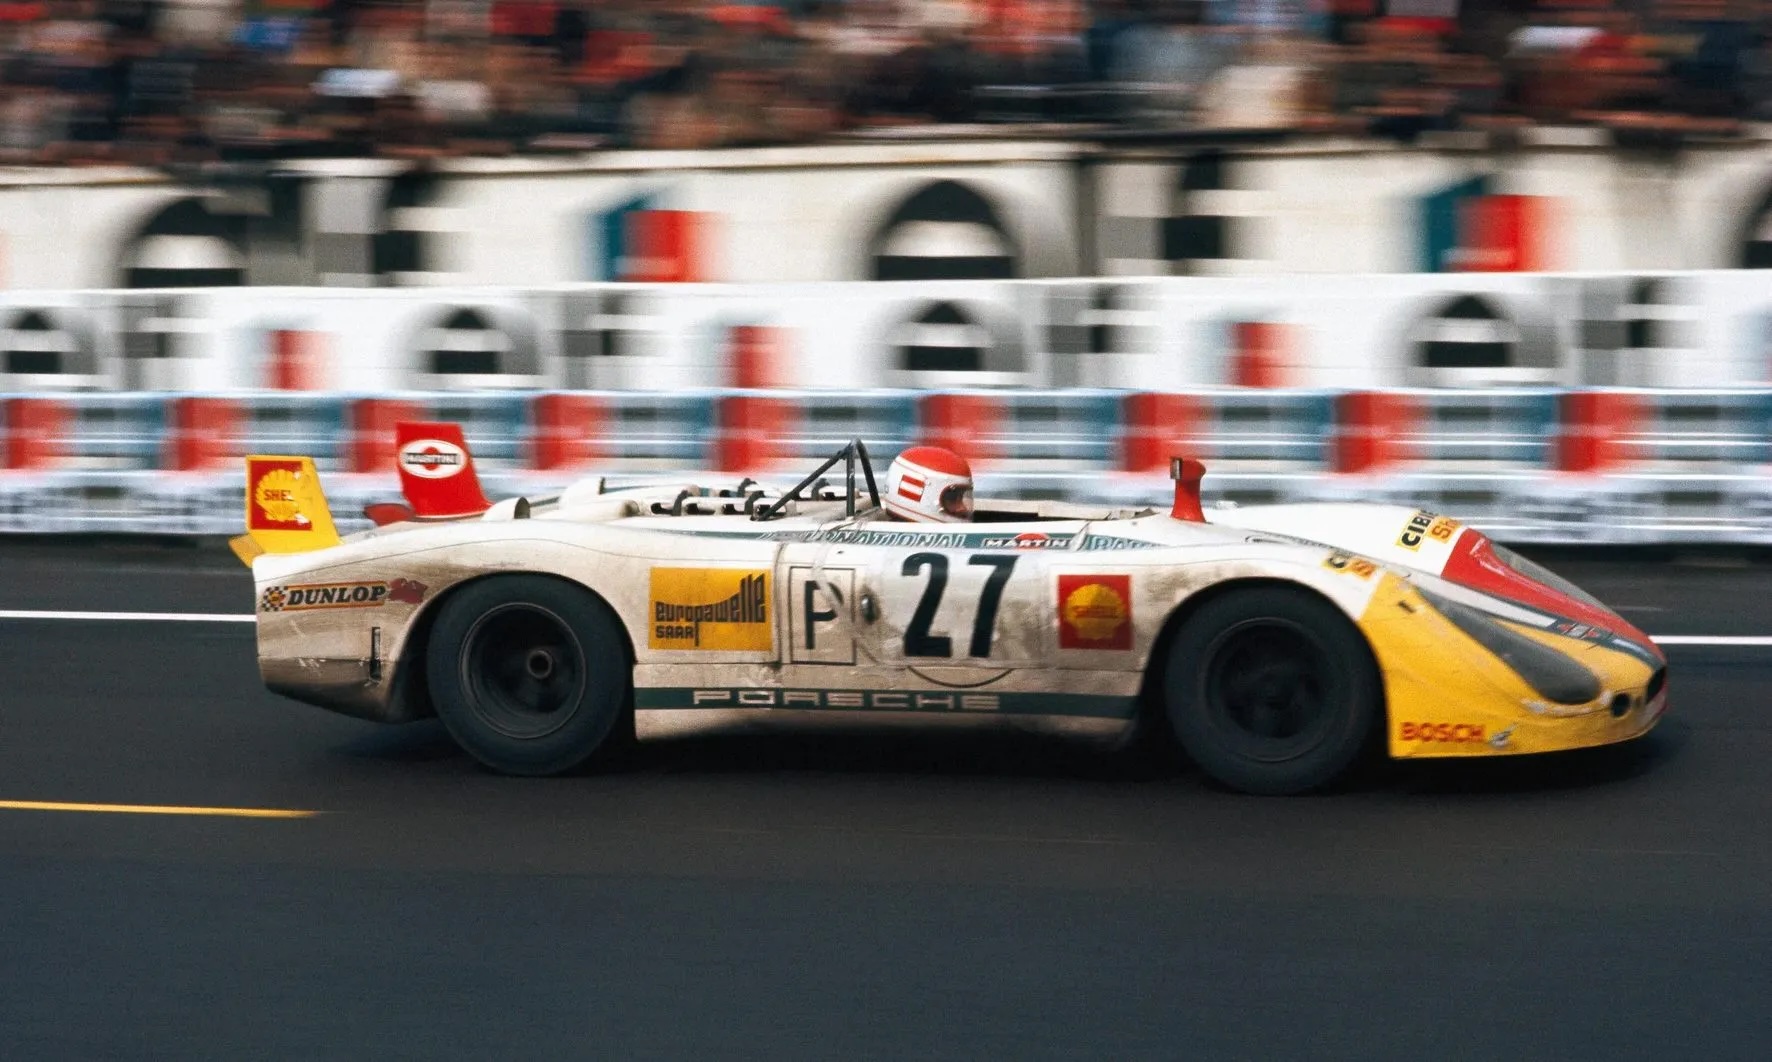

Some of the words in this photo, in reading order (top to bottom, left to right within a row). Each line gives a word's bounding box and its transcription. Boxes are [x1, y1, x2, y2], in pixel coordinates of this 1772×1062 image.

[287, 586, 387, 605] DUNLOP
[902, 552, 1021, 658] 27
[805, 580, 845, 650] P
[693, 690, 999, 710] PORSCHE
[1400, 722, 1485, 742] BOSCH
